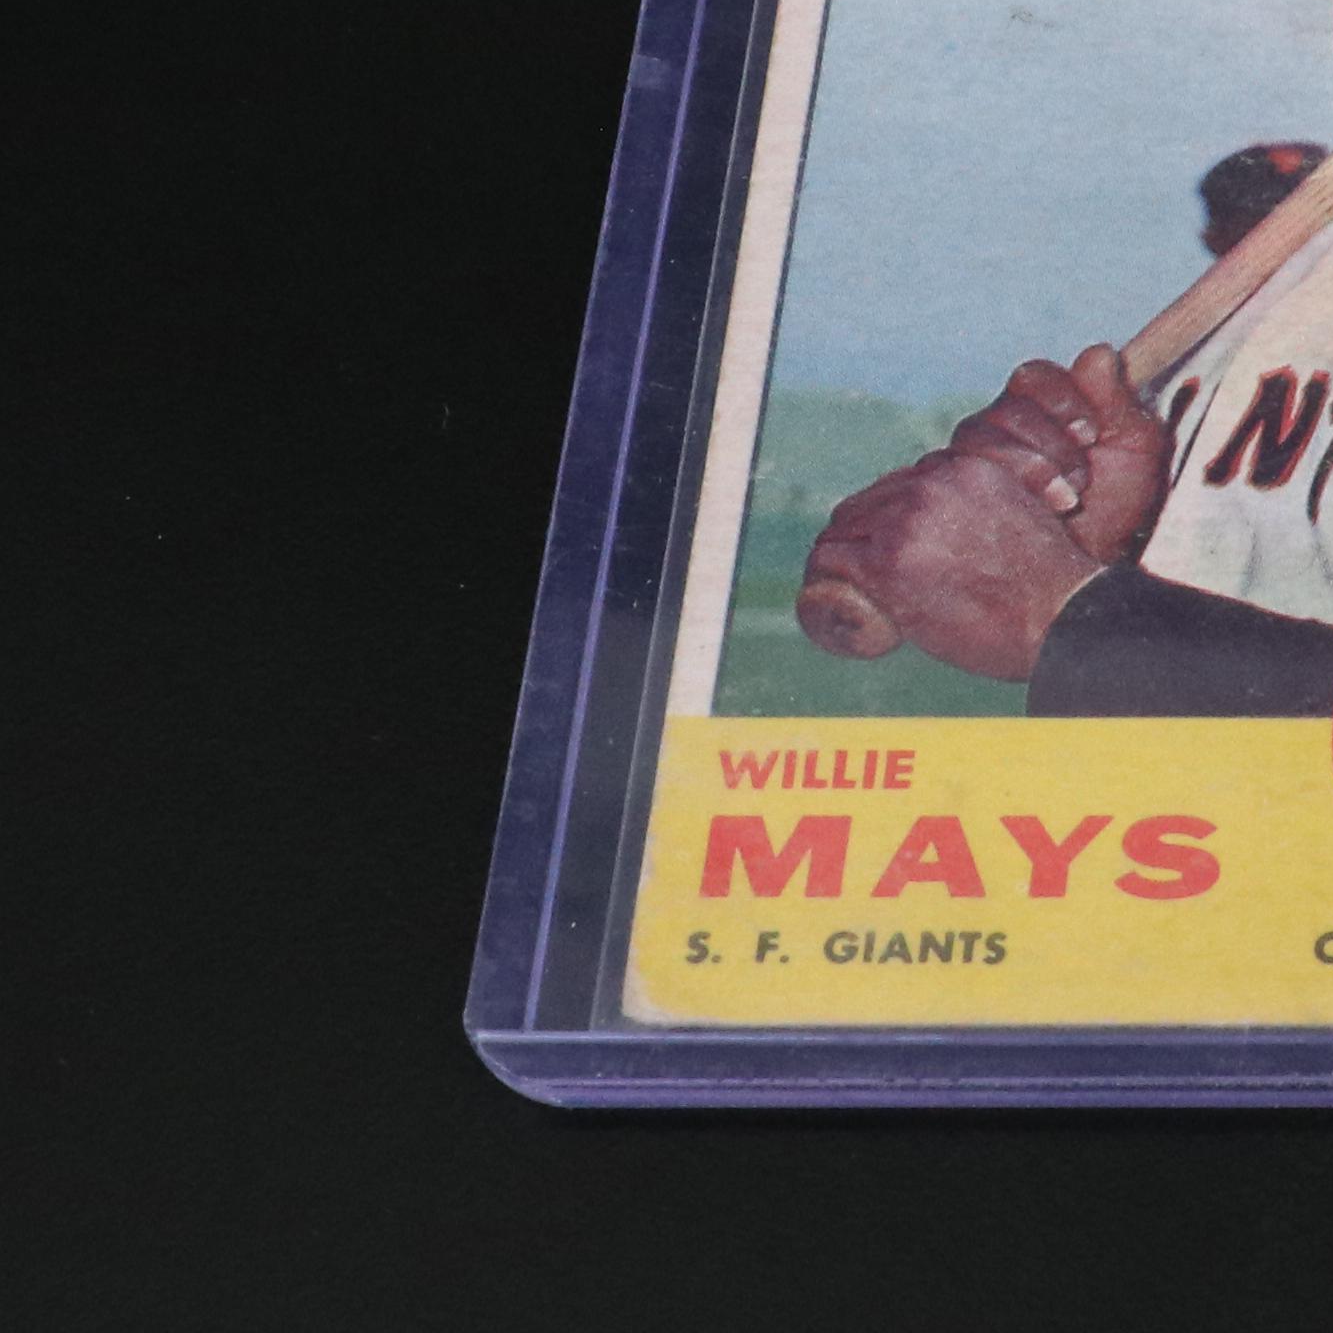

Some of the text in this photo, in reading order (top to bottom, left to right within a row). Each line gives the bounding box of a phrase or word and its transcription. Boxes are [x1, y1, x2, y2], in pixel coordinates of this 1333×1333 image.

[718, 748, 915, 790] WILLIE
[697, 814, 1222, 900] MAYS
[685, 932, 722, 965] S.
[755, 932, 790, 964] F.
[823, 931, 1007, 965] GIANTS
